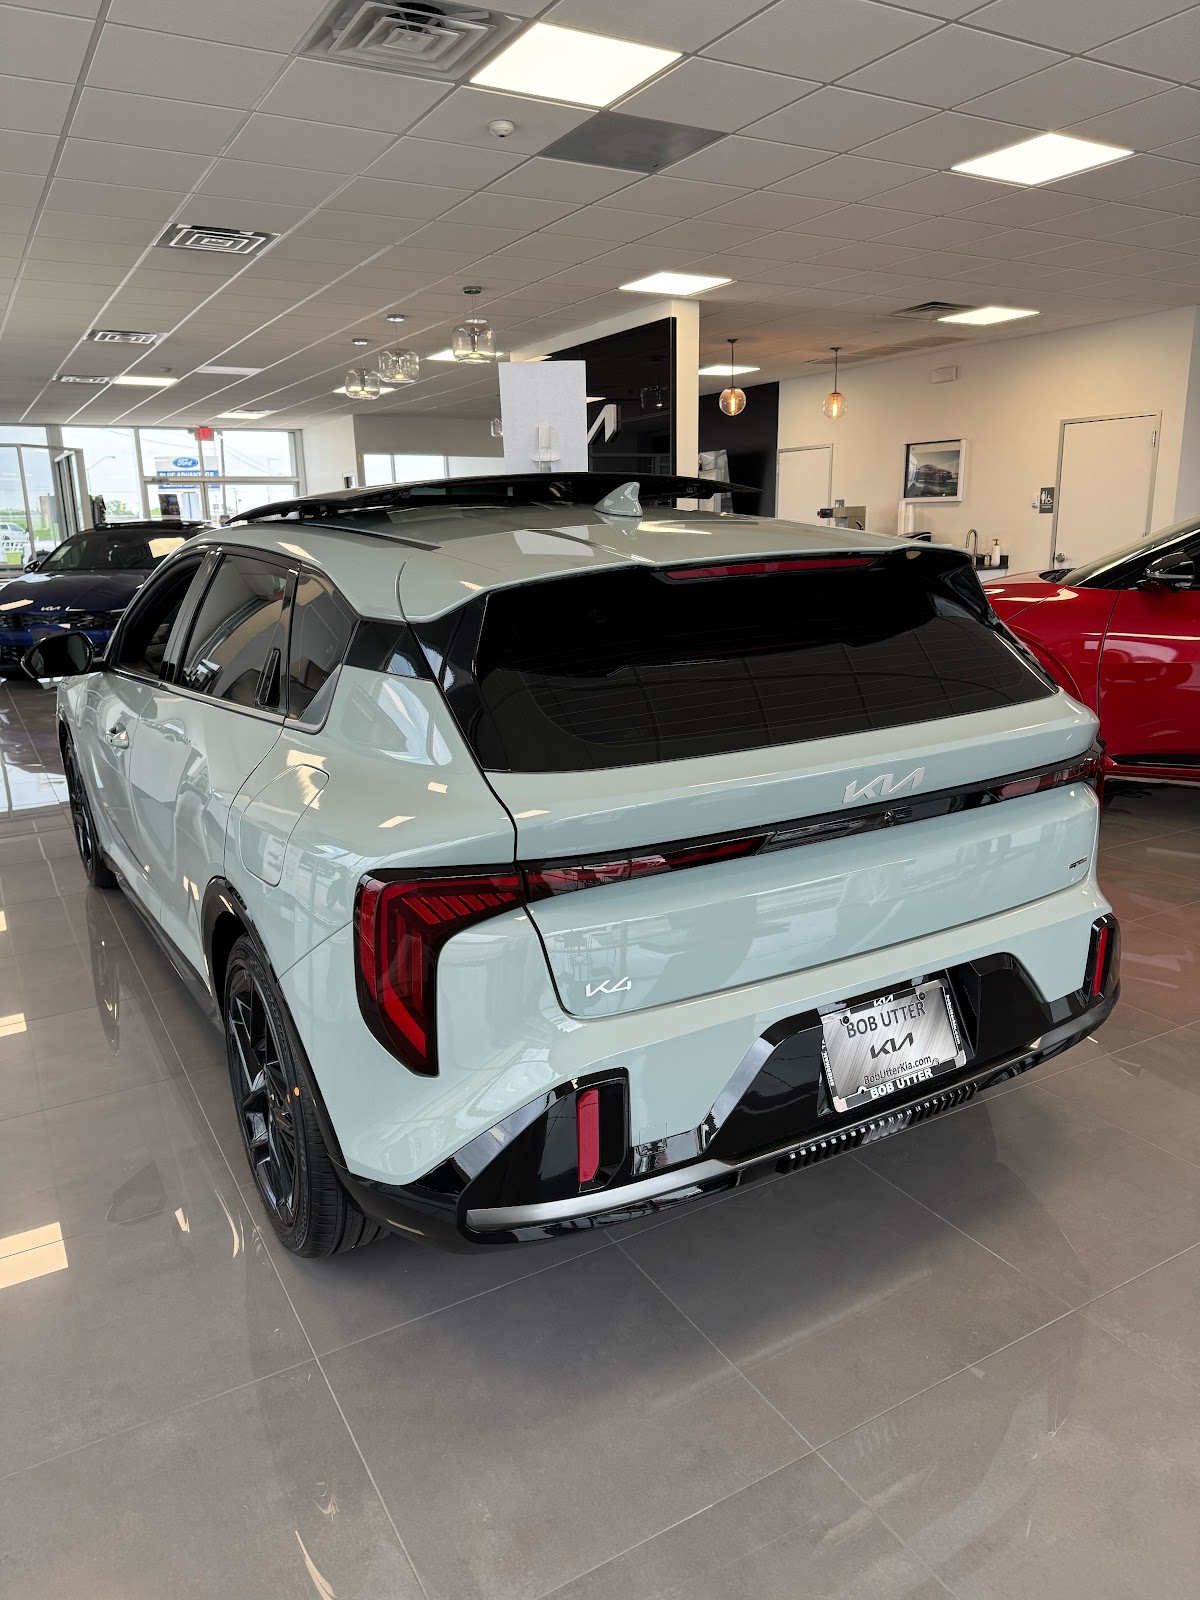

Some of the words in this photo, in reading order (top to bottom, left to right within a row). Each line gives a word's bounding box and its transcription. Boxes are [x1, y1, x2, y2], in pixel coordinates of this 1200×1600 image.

[842, 767, 925, 804] KIA
[585, 976, 632, 997] K4
[873, 994, 894, 1007] KIA
[846, 1016, 878, 1038] BOB
[880, 1002, 926, 1027] UTTER
[869, 1032, 914, 1060] KIA
[863, 1055, 932, 1085] BobUtterKia.com
[870, 1082, 896, 1099] BOB
[896, 1069, 934, 1089] UTTER
